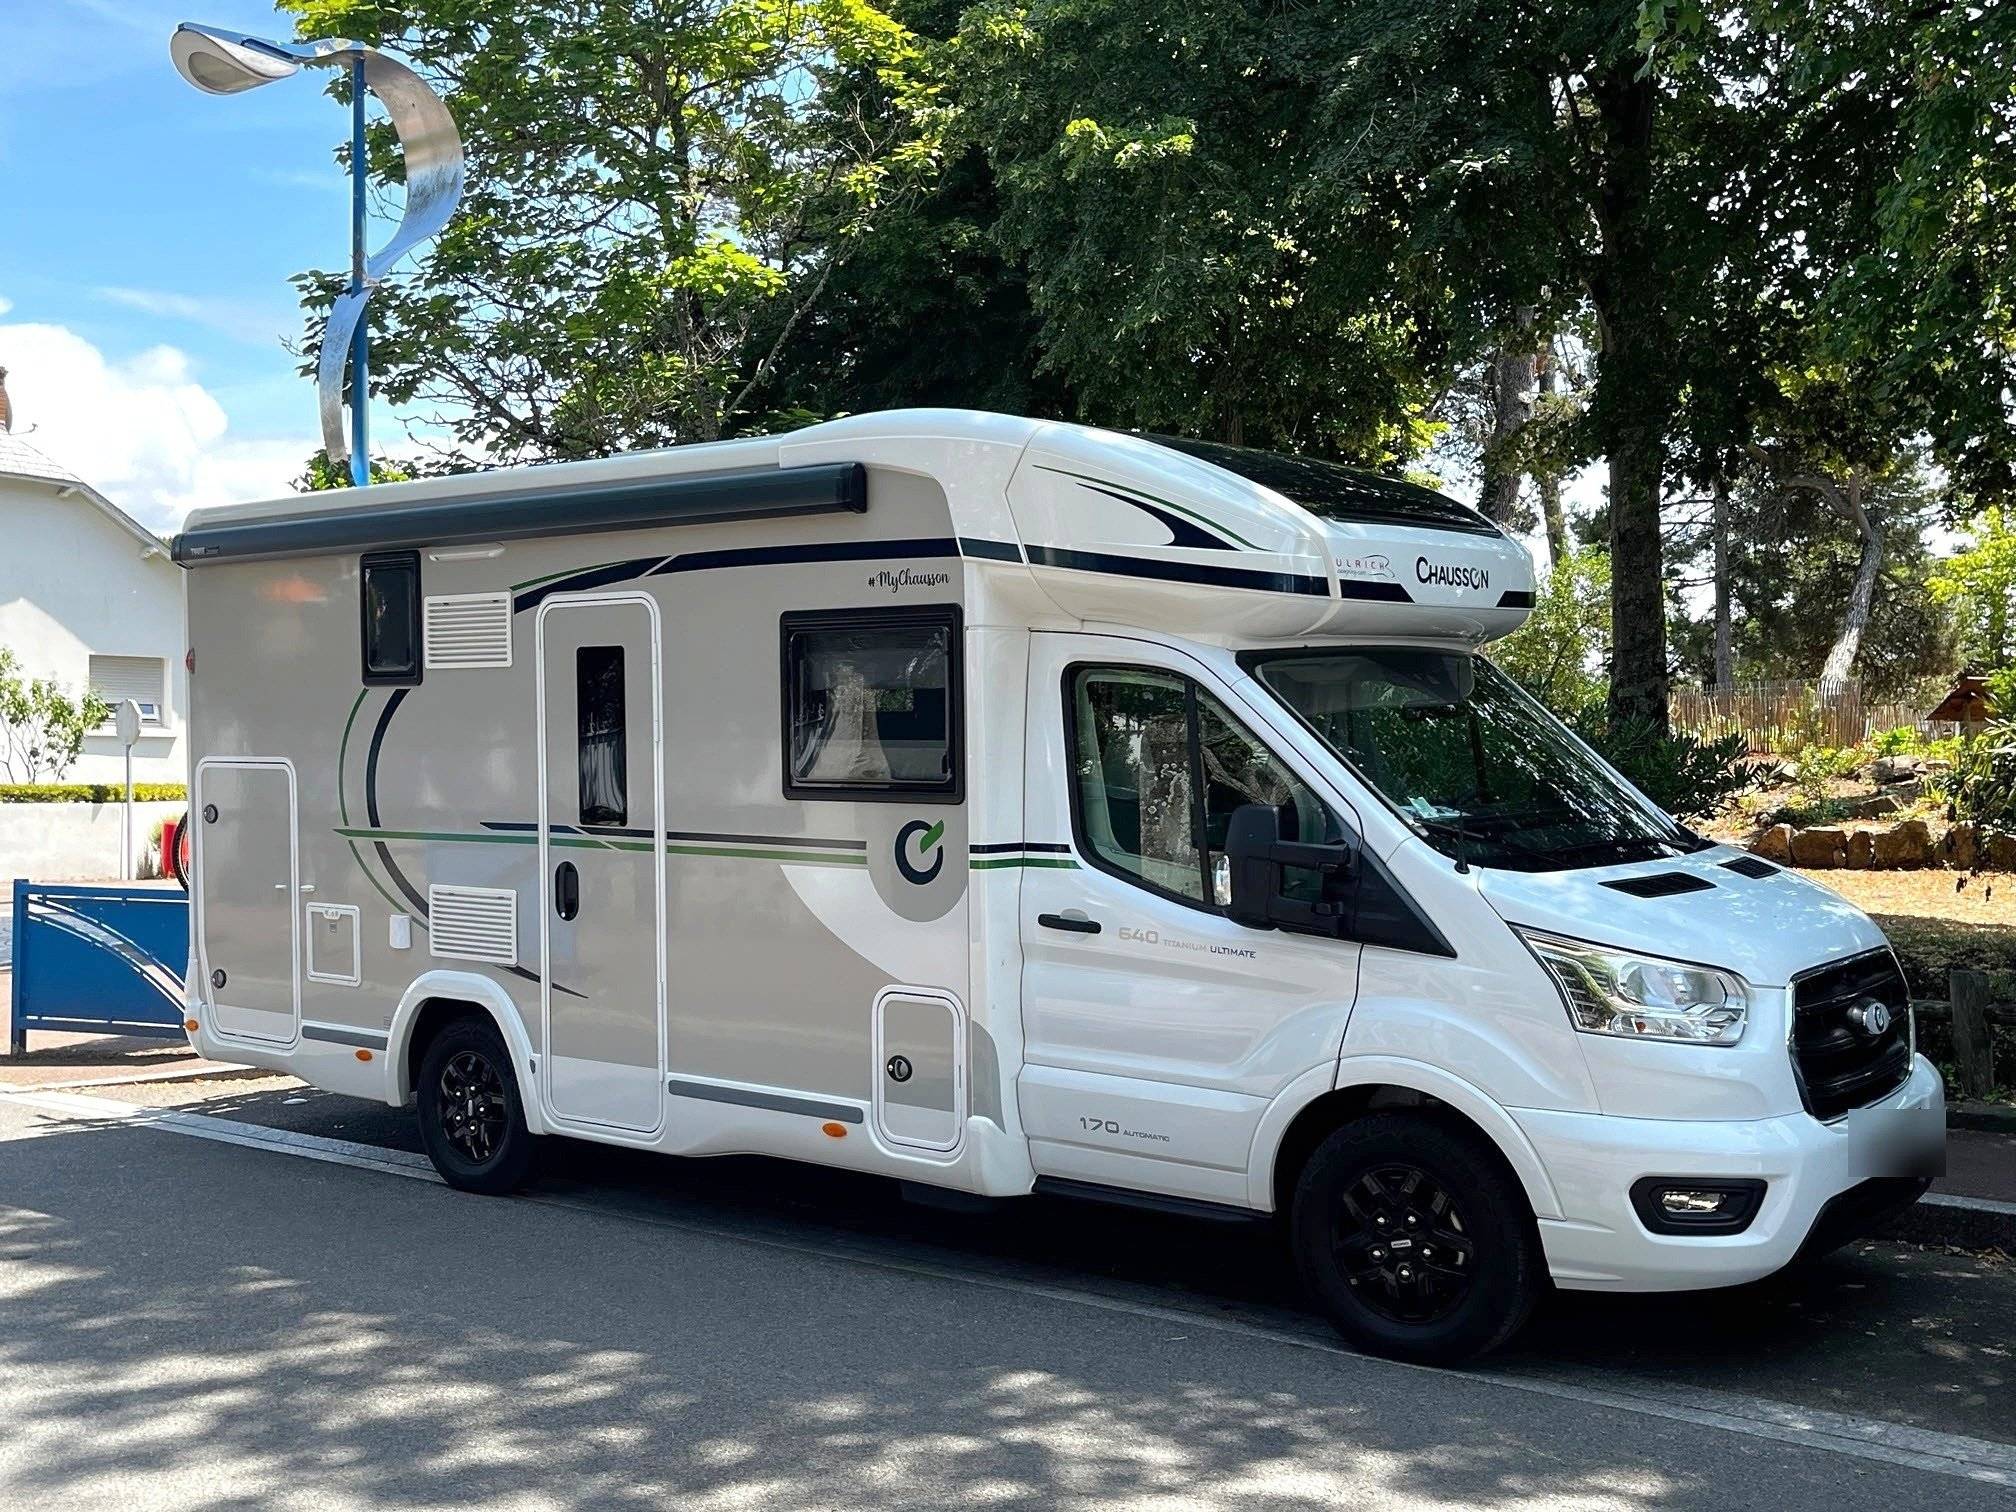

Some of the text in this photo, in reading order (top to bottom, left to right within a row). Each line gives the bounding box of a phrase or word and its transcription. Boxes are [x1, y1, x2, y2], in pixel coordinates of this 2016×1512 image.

[1336, 559, 1385, 570] ULRICH
[1416, 556, 1489, 590] CHAUSSON
[868, 568, 950, 593] #MyChausson
[1118, 926, 1257, 959] 640 TITANIUM ULTIMATE
[1080, 1116, 1171, 1142] 170 AUTOMATIC
